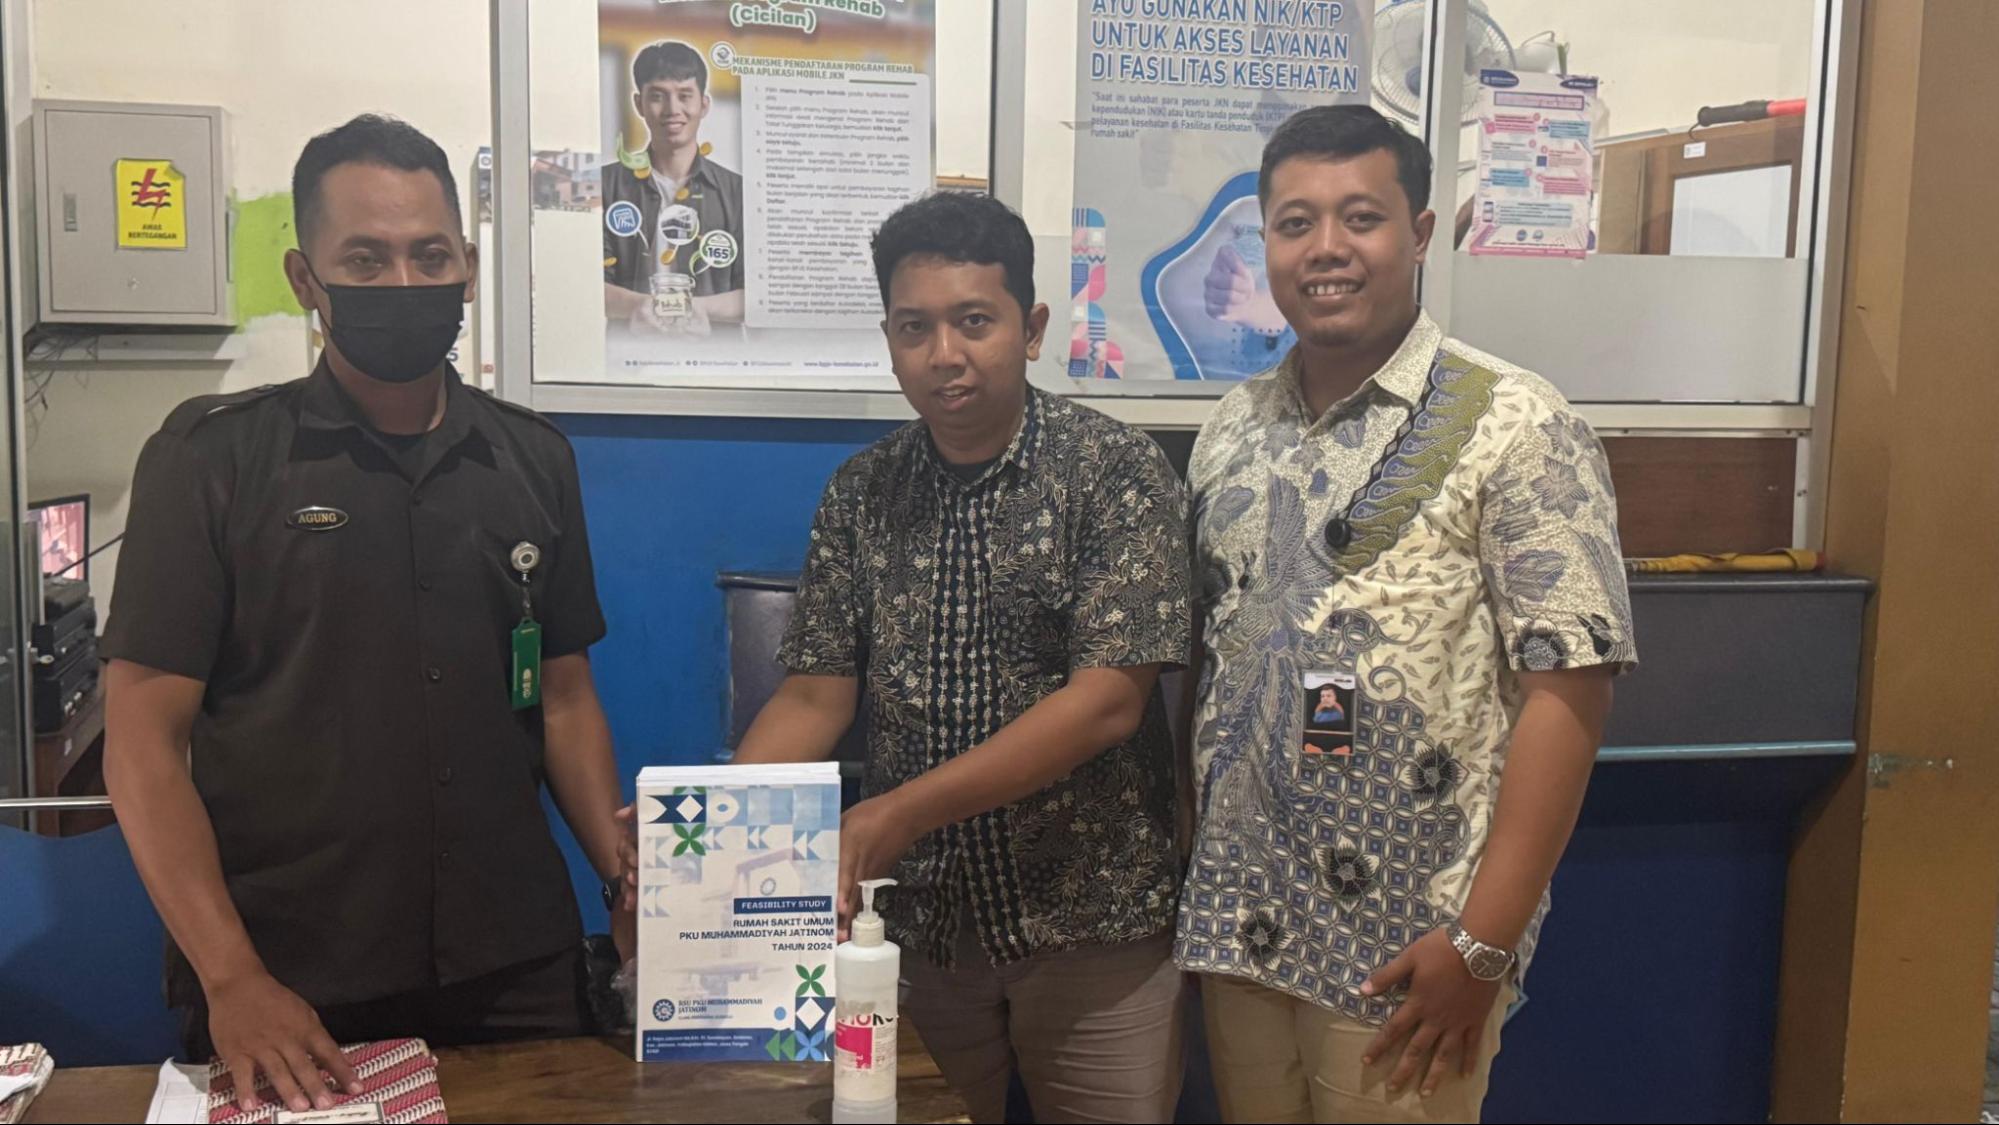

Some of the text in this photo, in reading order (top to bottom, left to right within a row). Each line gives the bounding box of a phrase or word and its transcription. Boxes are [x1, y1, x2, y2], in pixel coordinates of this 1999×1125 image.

[732, 5, 815, 31] (Cicilan)
[1142, 0, 1245, 22] GUNAKAN
[1254, 0, 1342, 27] NIK/KTP
[1092, 20, 1348, 59] UNTUK AKSES LAYANAN
[732, 56, 782, 67] MEKANISME
[784, 59, 843, 70] PENDAFTARAN
[845, 62, 885, 73] PROGRAM
[732, 66, 845, 80] PADA APLIKASI MOBILE JKN
[1092, 53, 1357, 90] DI FASILITAS KESEHATAN
[707, 247, 729, 259] 165
[298, 512, 337, 524] AGUNG
[741, 900, 826, 909] FEASIBILITY STUDY
[733, 917, 834, 927] RUMAH SAKIT UMUM
[679, 928, 834, 940] PKU MUHAMMADIYAH JATINOM
[772, 942, 833, 951] TAHUN 2024
